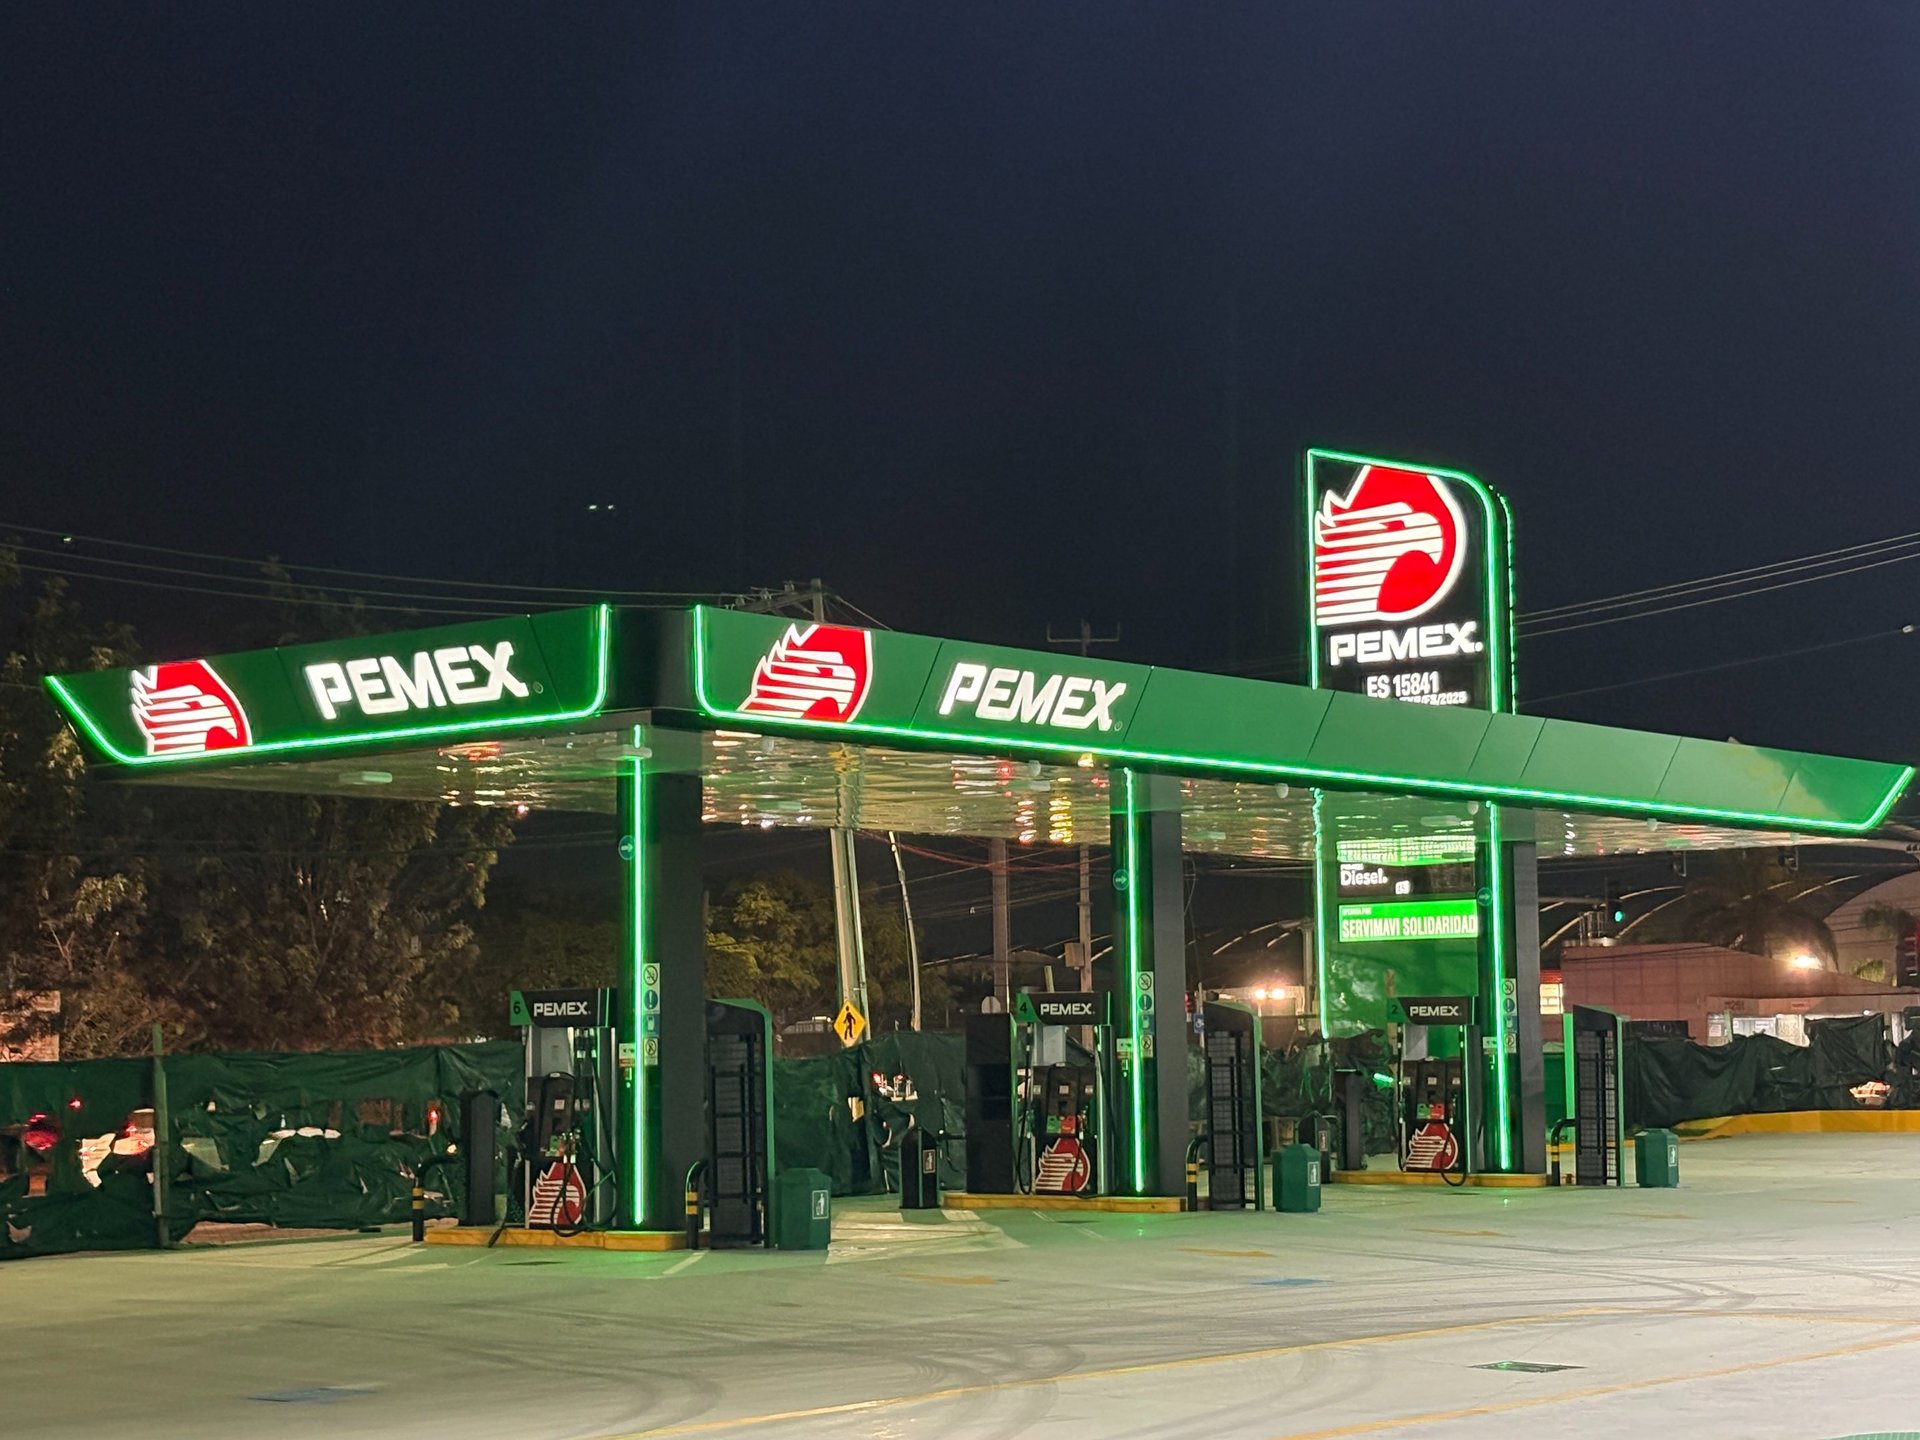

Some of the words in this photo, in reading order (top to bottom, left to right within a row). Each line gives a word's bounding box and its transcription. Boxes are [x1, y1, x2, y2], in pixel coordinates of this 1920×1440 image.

[1330, 621, 1476, 666] PEMEX
[304, 641, 529, 720] PEMEX
[1367, 675, 1391, 698] ES
[1393, 671, 1439, 697] 15841
[939, 662, 1126, 731] PEMEX
[1340, 868, 1383, 886] Diesel
[1342, 918, 1399, 938] SERVIMAVI
[1403, 915, 1478, 936] SOLIDARIDAD
[514, 1002, 521, 1015] 6
[533, 1000, 588, 1017] PEMEX
[1019, 1003, 1028, 1014] 4
[1040, 1002, 1093, 1015] PEMEX
[1391, 1005, 1398, 1014] 2
[1409, 1005, 1460, 1017] PEMEX
